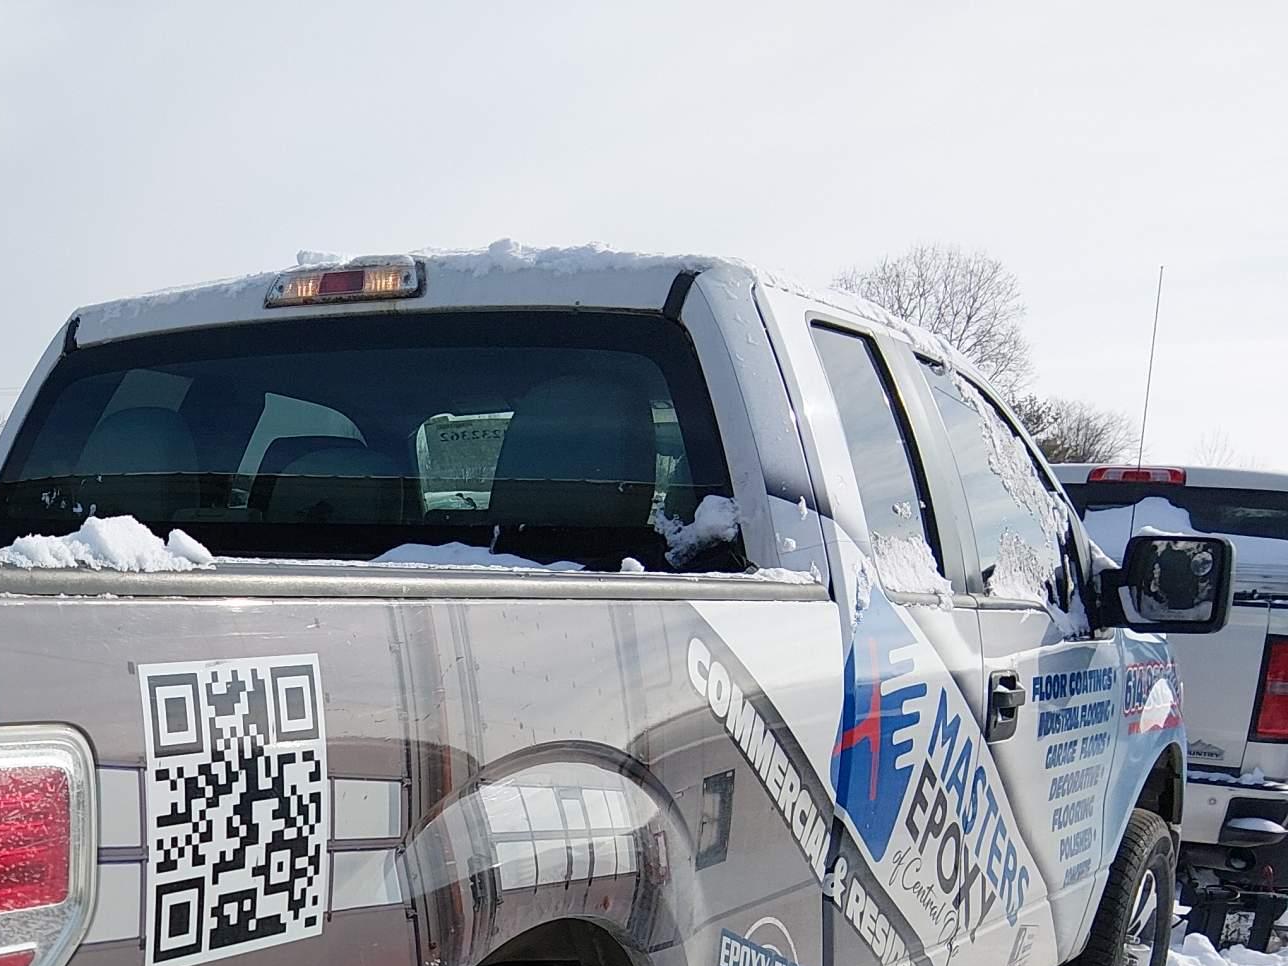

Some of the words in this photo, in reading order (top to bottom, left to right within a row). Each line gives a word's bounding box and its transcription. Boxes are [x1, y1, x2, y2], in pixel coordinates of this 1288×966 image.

[1032, 672, 1068, 703] FLOOR
[1069, 666, 1114, 696] COATINGS
[686, 636, 833, 885] COMMERCIAL
[823, 851, 850, 900] &
[1045, 738, 1078, 770] GARAGE
[928, 686, 1030, 928] MASTERS
[1052, 796, 1095, 833] FLOORING
[888, 846, 912, 887] of
[901, 856, 947, 926] Central
[904, 758, 996, 944] EPOXY
